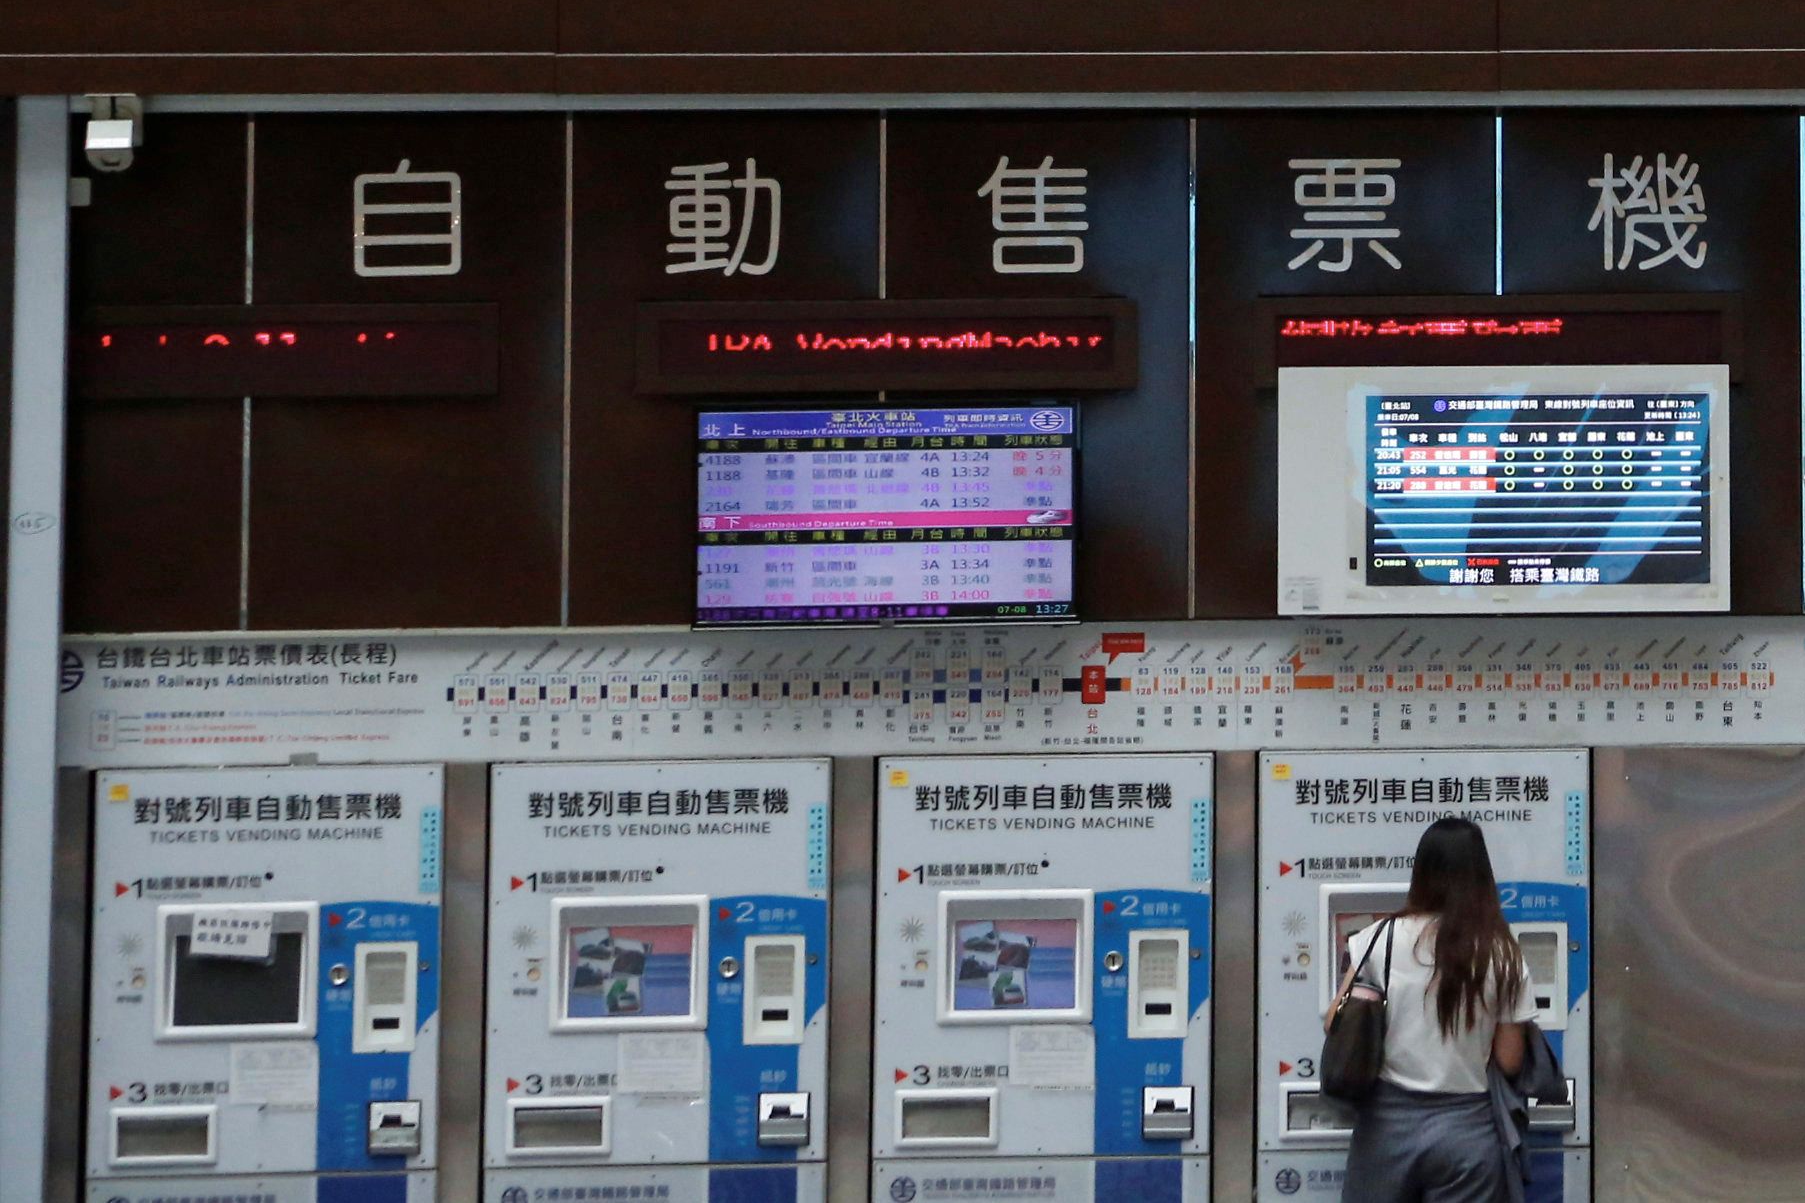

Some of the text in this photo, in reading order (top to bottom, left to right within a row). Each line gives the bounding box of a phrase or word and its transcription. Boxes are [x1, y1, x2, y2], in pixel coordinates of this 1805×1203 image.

[354, 153, 1707, 277] 自動售票機
[704, 424, 746, 436] 北上
[920, 451, 940, 462] 4A
[951, 451, 989, 462] 13:24
[706, 466, 989, 481] 1188 4B 13:32
[705, 497, 990, 512] 2164 4A 13:52
[706, 559, 989, 573] 1191 3A 13:34
[952, 574, 990, 585] 13:40
[1449, 568, 1599, 583] 謝謝您 搭乘臺灣鐵路
[997, 604, 1069, 614] 07-08 13:27
[102, 672, 418, 689] Taiwan Railways Administration Ticket Fare
[915, 783, 1172, 812] 對號列車自動售票機
[1296, 776, 1549, 805] 對號列車自動售票機
[134, 792, 401, 824] 對號列車自動售票機
[528, 788, 789, 818] 對號列車自動售票機
[931, 816, 1154, 831] TICKETS VENDING MACHINE
[1311, 811, 1376, 824] TICKETS
[1462, 809, 1532, 822] MACHINE
[151, 827, 383, 844] TICKETS VENDING MACHINE
[544, 822, 771, 838] TICKETS VENDING MACHINE
[913, 1065, 931, 1085] 3
[1298, 1058, 1315, 1078] 3
[525, 1074, 543, 1094] 3
[129, 1082, 147, 1103] 3
